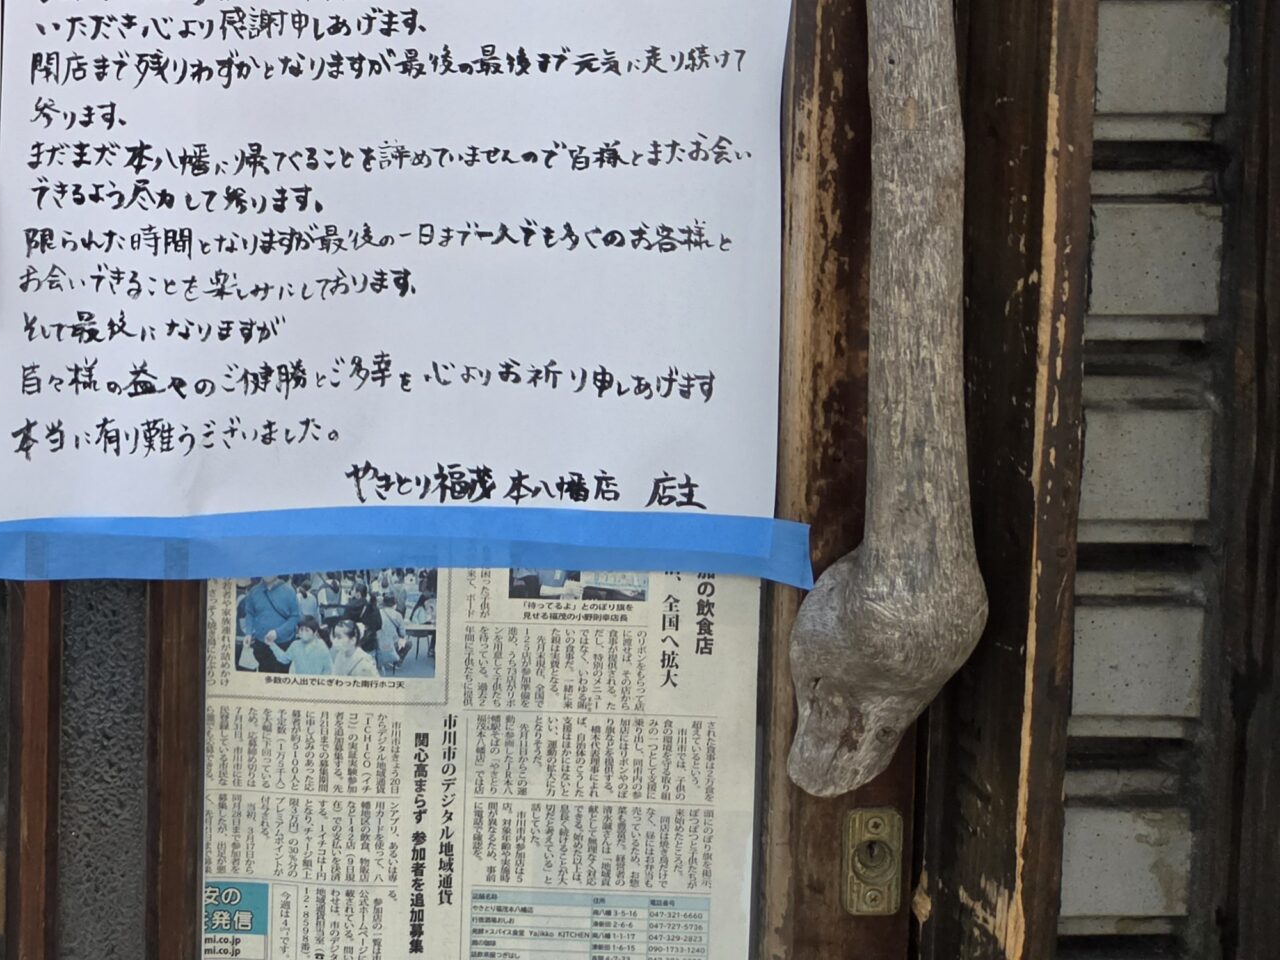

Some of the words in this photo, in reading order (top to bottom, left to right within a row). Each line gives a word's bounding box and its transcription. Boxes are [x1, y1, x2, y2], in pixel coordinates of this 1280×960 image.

[645, 470, 708, 510] 店主
[660, 571, 681, 688] 、全国へ拡大
[413, 732, 430, 824] 関心高まらず
[437, 714, 458, 906] 市川市のデジタル地域通貨
[409, 831, 427, 954] 参加者を追加募集
